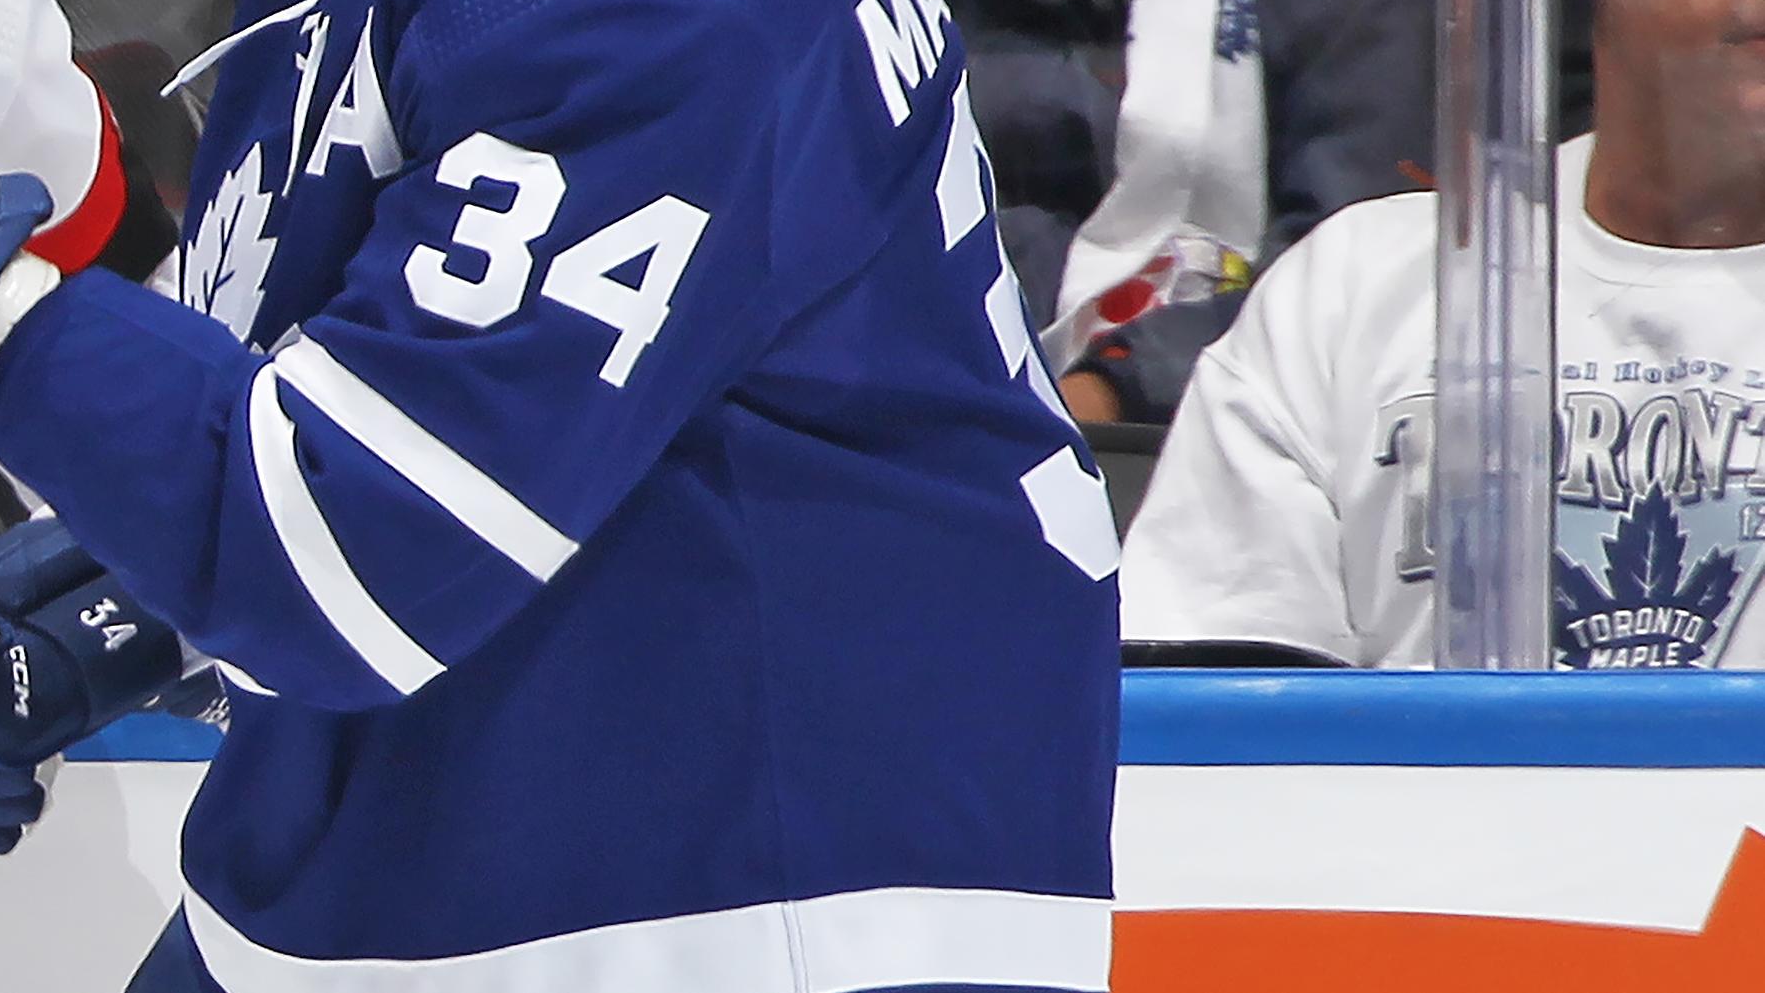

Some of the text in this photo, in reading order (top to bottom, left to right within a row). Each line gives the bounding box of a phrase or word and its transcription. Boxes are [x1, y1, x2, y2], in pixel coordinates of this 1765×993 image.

[305, 6, 404, 181] A
[403, 131, 712, 389] 34
[79, 596, 139, 653] 34
[1565, 607, 1707, 649] TORONTO
[1586, 641, 1683, 669] MAPLE
[8, 644, 31, 720] CCM
